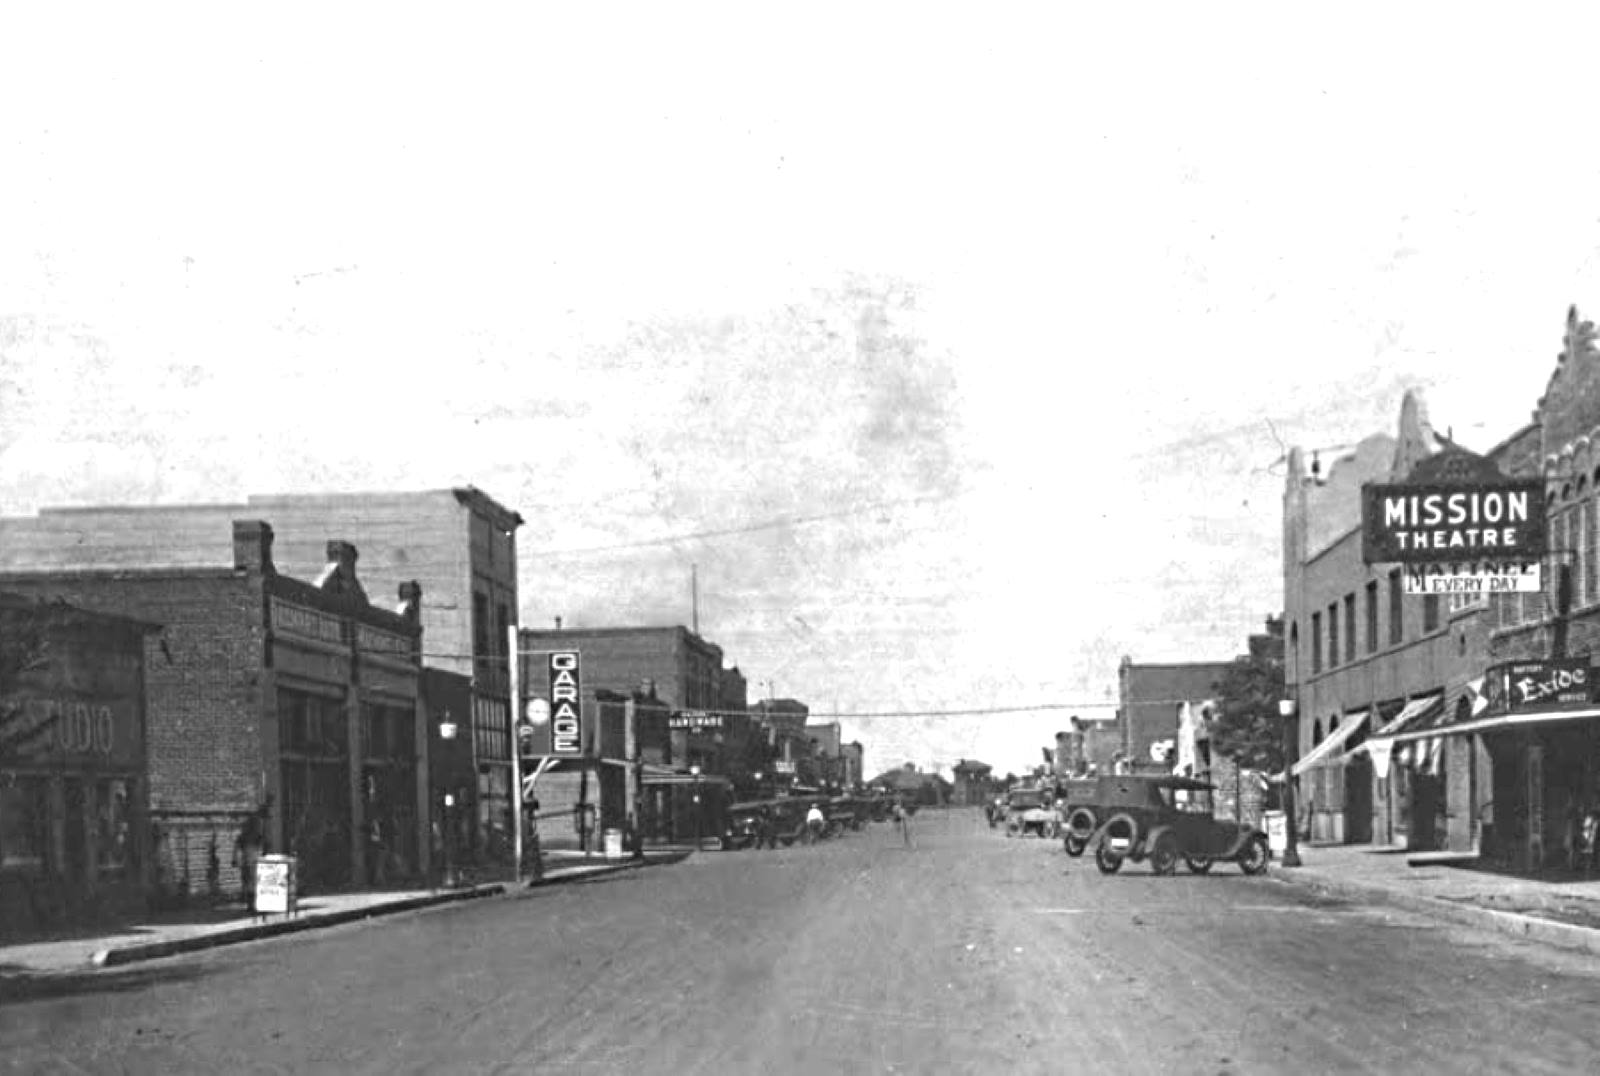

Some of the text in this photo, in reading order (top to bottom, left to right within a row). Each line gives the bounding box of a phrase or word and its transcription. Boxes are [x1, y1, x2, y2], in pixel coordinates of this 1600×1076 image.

[1385, 491, 1528, 527] MISSION
[1395, 528, 1517, 549] THEATRE
[1432, 577, 1519, 592] EVERY DAY
[552, 653, 579, 751] GARAGE
[1516, 668, 1586, 703] Exide
